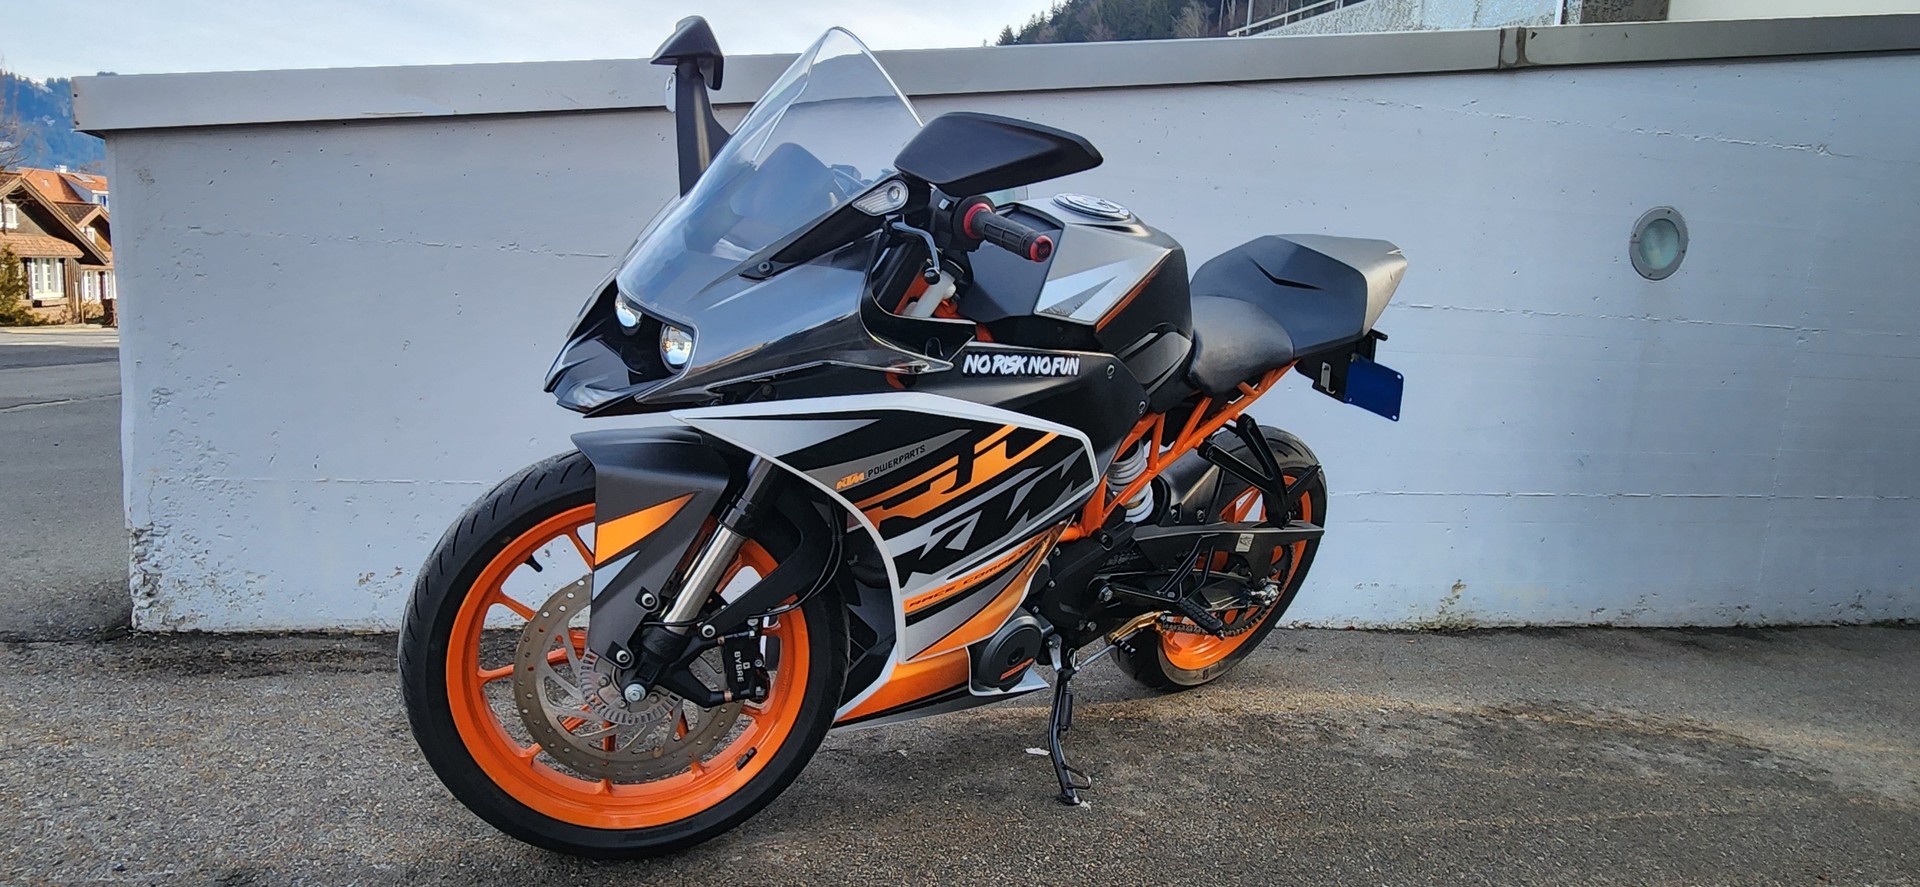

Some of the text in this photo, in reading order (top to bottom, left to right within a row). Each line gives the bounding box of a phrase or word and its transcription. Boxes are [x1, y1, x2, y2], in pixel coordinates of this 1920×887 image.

[963, 354, 1080, 376] NO RISK NO FUN
[836, 445, 926, 490] KTM POWERPARTS
[734, 651, 745, 682] BYBRE
